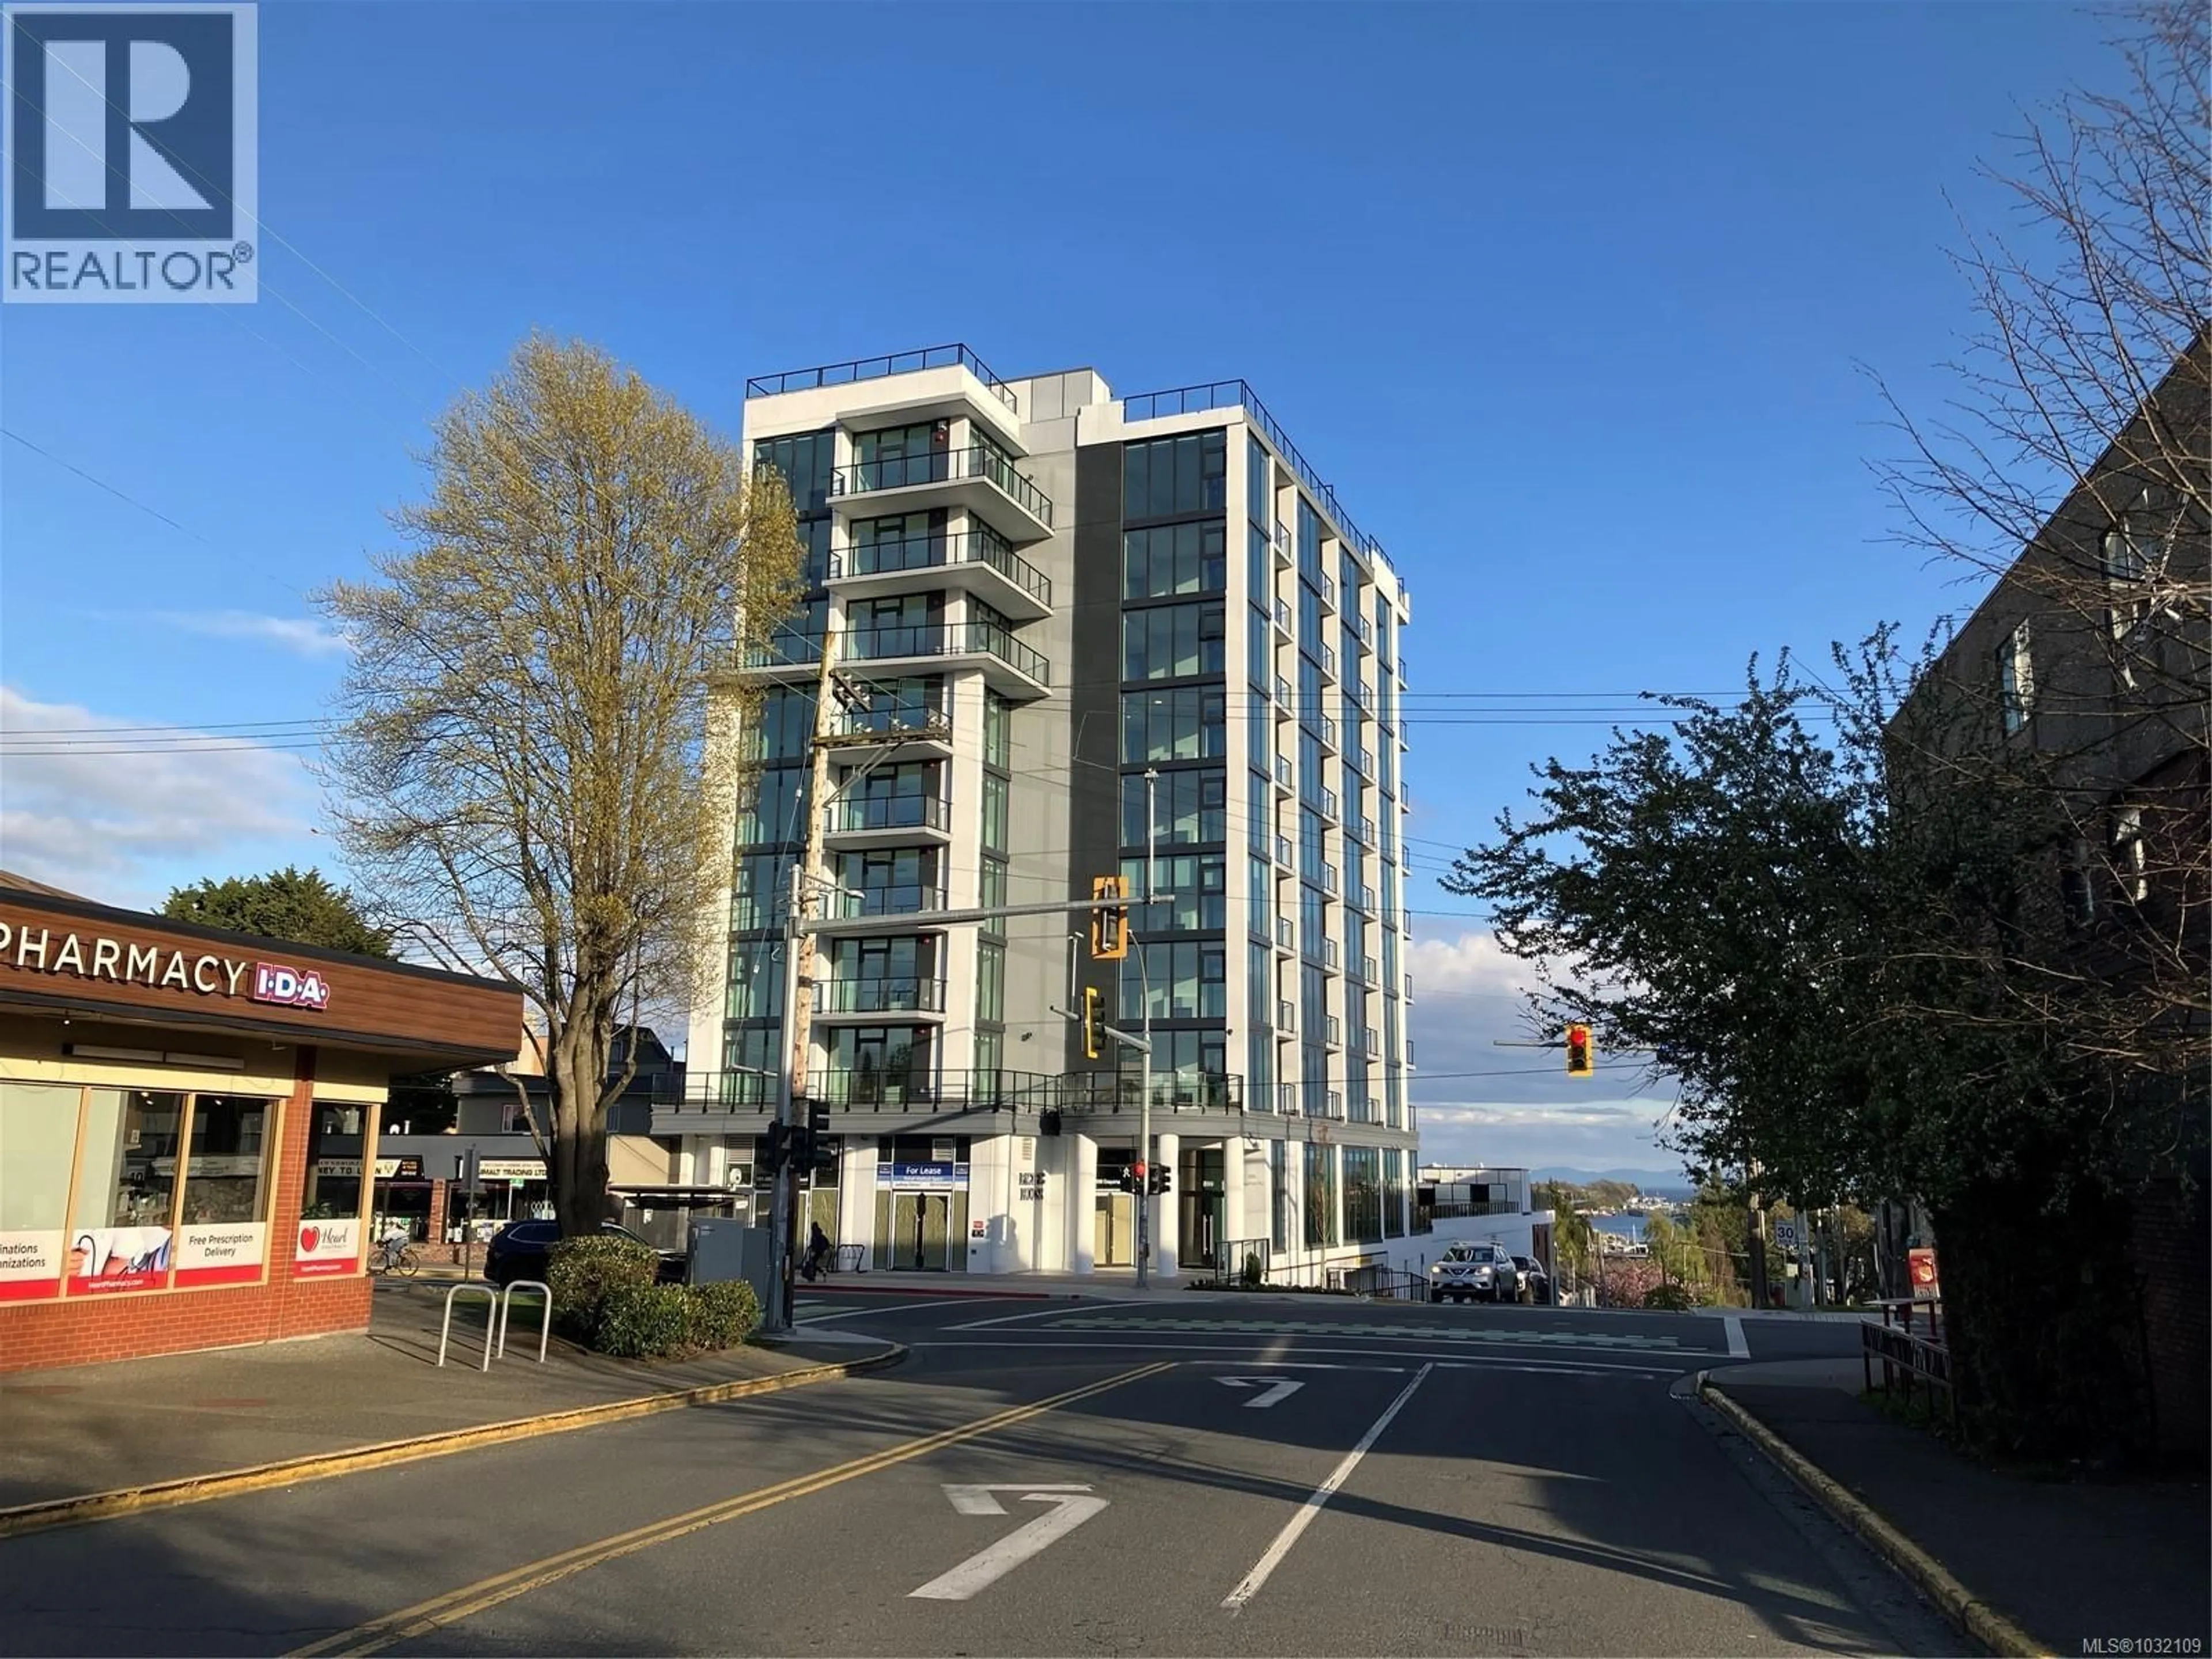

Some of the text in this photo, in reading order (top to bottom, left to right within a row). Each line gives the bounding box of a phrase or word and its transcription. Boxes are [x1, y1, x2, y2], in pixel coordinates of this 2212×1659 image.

[906, 1166, 942, 1175] For Lease
[1778, 1226, 1793, 1238] 30
[189, 1233, 253, 1245] Free Prescription
[204, 1247, 237, 1257] Delivery
